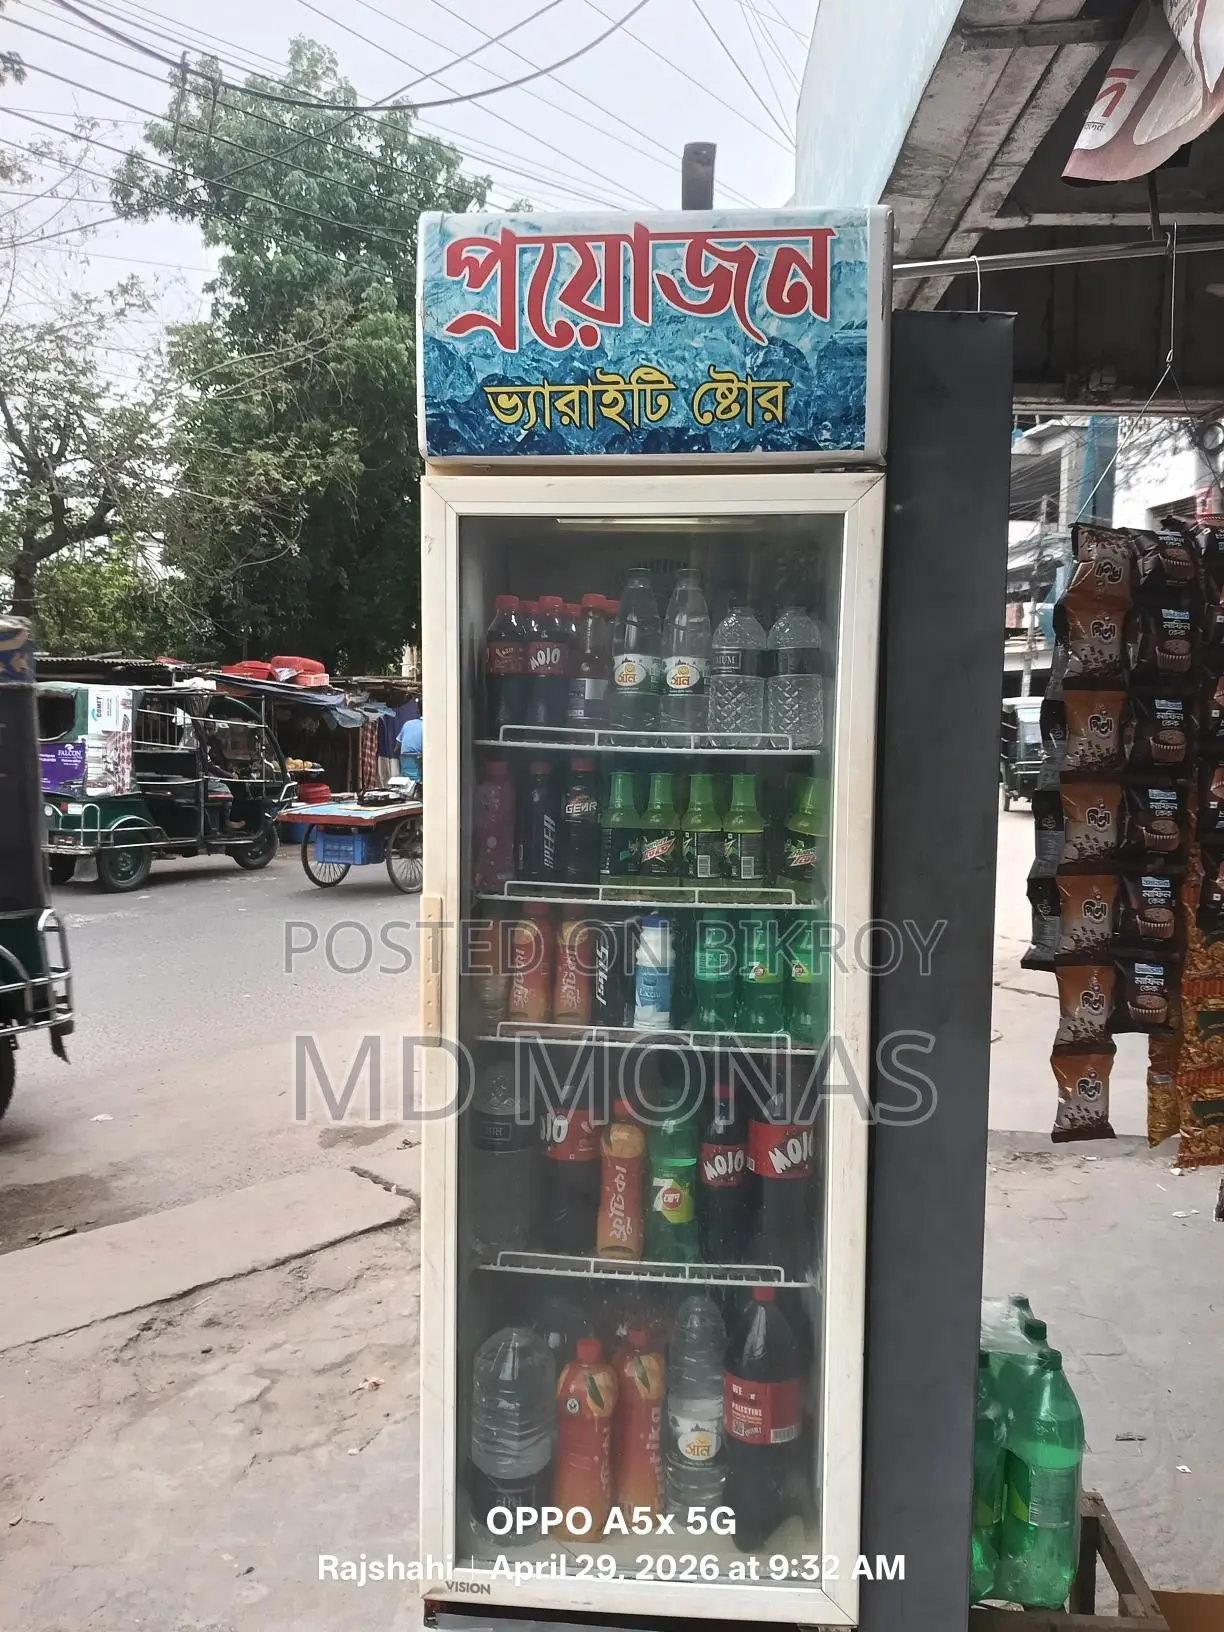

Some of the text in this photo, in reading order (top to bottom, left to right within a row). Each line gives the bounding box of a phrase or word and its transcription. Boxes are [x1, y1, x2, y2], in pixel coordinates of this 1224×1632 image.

[444, 222, 836, 351] প্রয়োজন
[484, 365, 791, 431] ভ্যারাইটি ষ্টোর
[529, 647, 561, 671] MOJO
[58, 749, 82, 757] FALCON
[565, 801, 598, 814] GEAR
[543, 814, 556, 869] SPEED
[703, 1150, 744, 1181] MOJO
[732, 1384, 743, 1395] WE
[732, 1402, 763, 1417] PALESTINE
[445, 1580, 491, 1594] VISION
